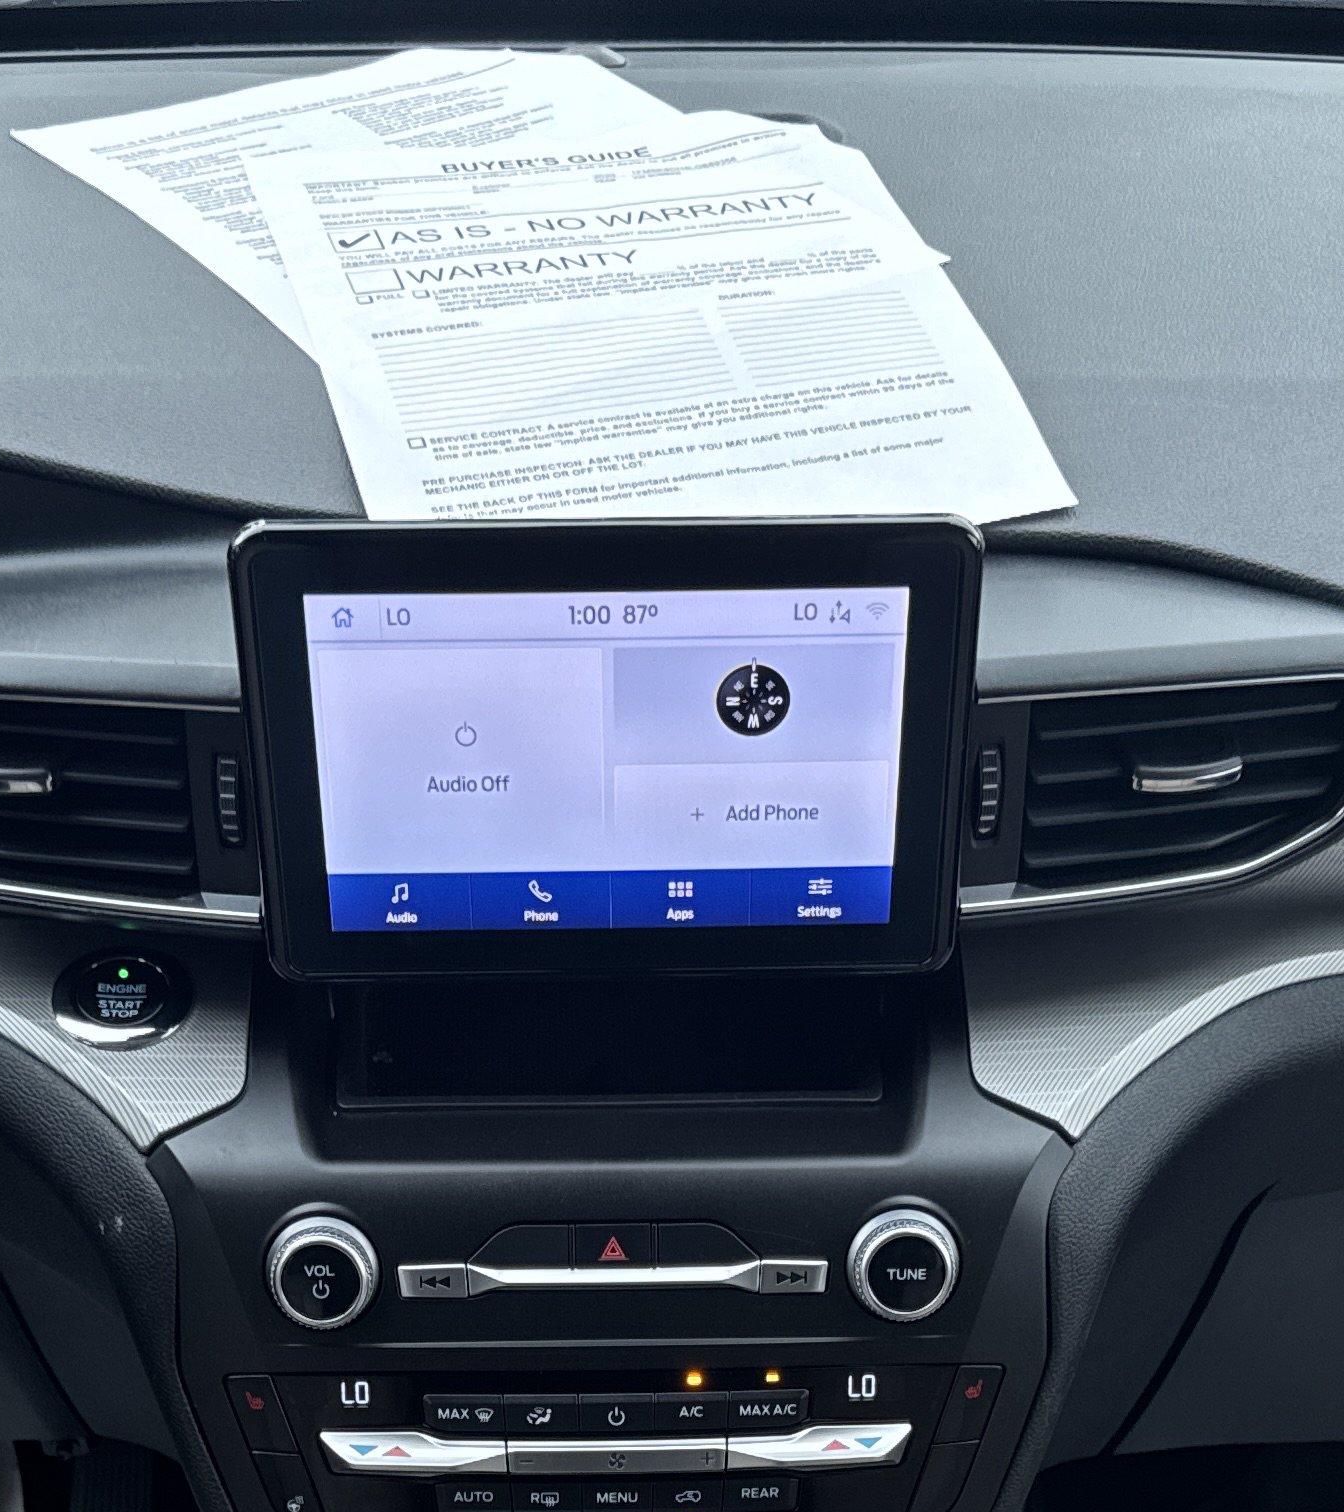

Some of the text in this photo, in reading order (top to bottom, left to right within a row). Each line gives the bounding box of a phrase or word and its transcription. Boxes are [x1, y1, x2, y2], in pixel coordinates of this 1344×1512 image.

[441, 147, 649, 174] BUYER'S GUIDE
[391, 192, 816, 245] AS IS NO WARRANTY
[406, 249, 638, 284] WARRANTY
[386, 608, 411, 626] LO
[567, 605, 611, 625] 1:00
[793, 603, 818, 621] LO
[750, 673, 759, 688] E
[427, 774, 511, 794] Audio Off
[726, 802, 819, 822] Add Phone
[386, 909, 418, 924] Audio
[523, 908, 559, 924] Phone
[666, 907, 695, 923] Apps
[797, 904, 842, 920] Settings
[97, 983, 147, 993] ENGINE
[98, 1000, 144, 1009] START
[100, 1009, 139, 1018] STOP
[304, 1264, 335, 1277] VOL
[887, 1268, 927, 1281] TUNE
[340, 1380, 370, 1405] LO
[847, 1373, 876, 1399] LO
[437, 1408, 470, 1420] MAX
[679, 1405, 704, 1418] A/C
[739, 1403, 798, 1417] MAX A/C
[454, 1490, 493, 1503] AUTO
[596, 1491, 638, 1504] MENU
[741, 1486, 779, 1499] REAR
